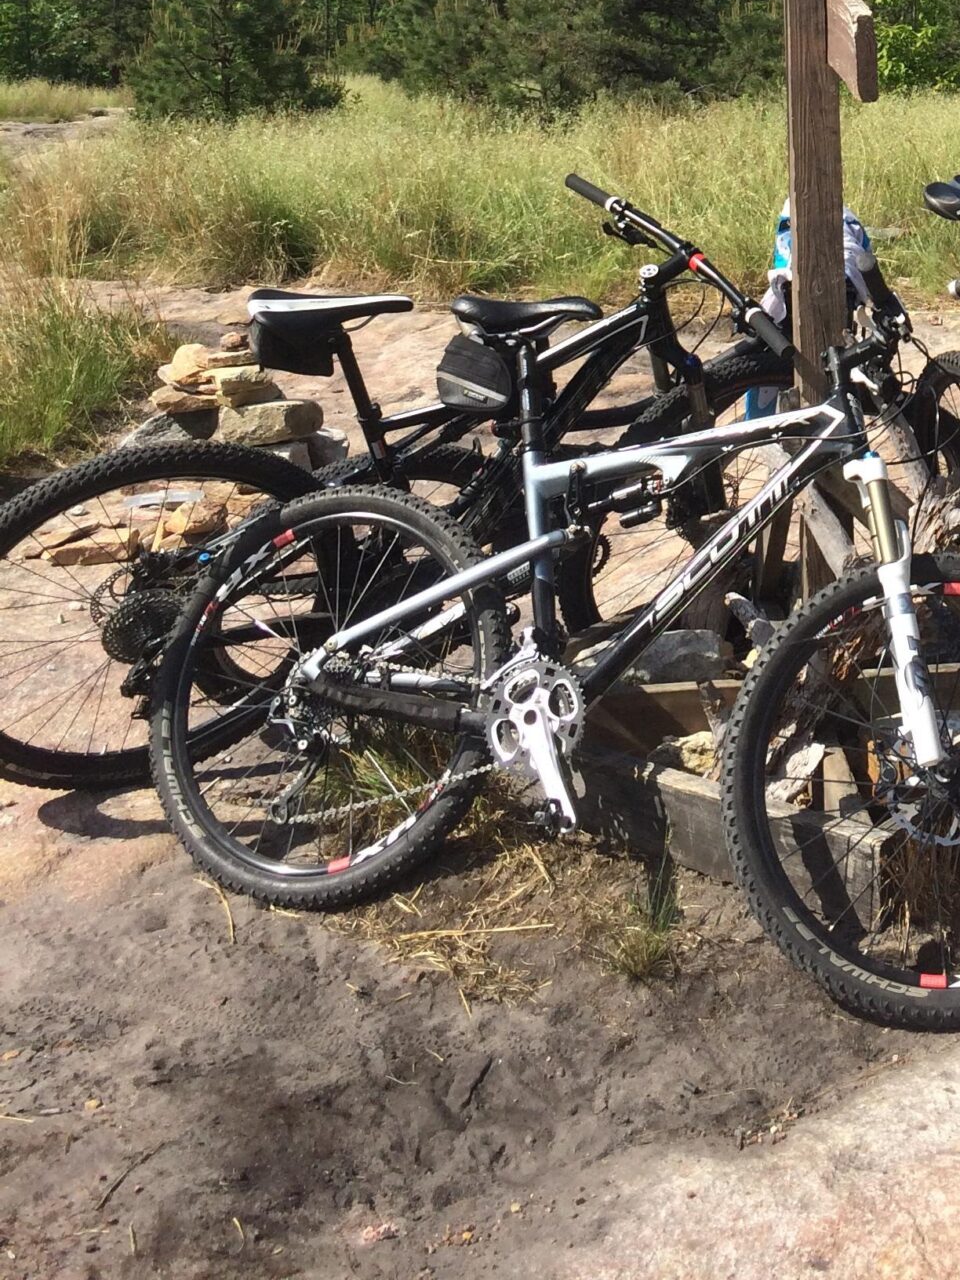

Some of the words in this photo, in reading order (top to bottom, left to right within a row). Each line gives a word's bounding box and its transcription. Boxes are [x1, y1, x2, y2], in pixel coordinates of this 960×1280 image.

[653, 462, 793, 623] SCOTT
[161, 700, 207, 840] SCHWALBE
[782, 905, 932, 998] SCHWALBE
